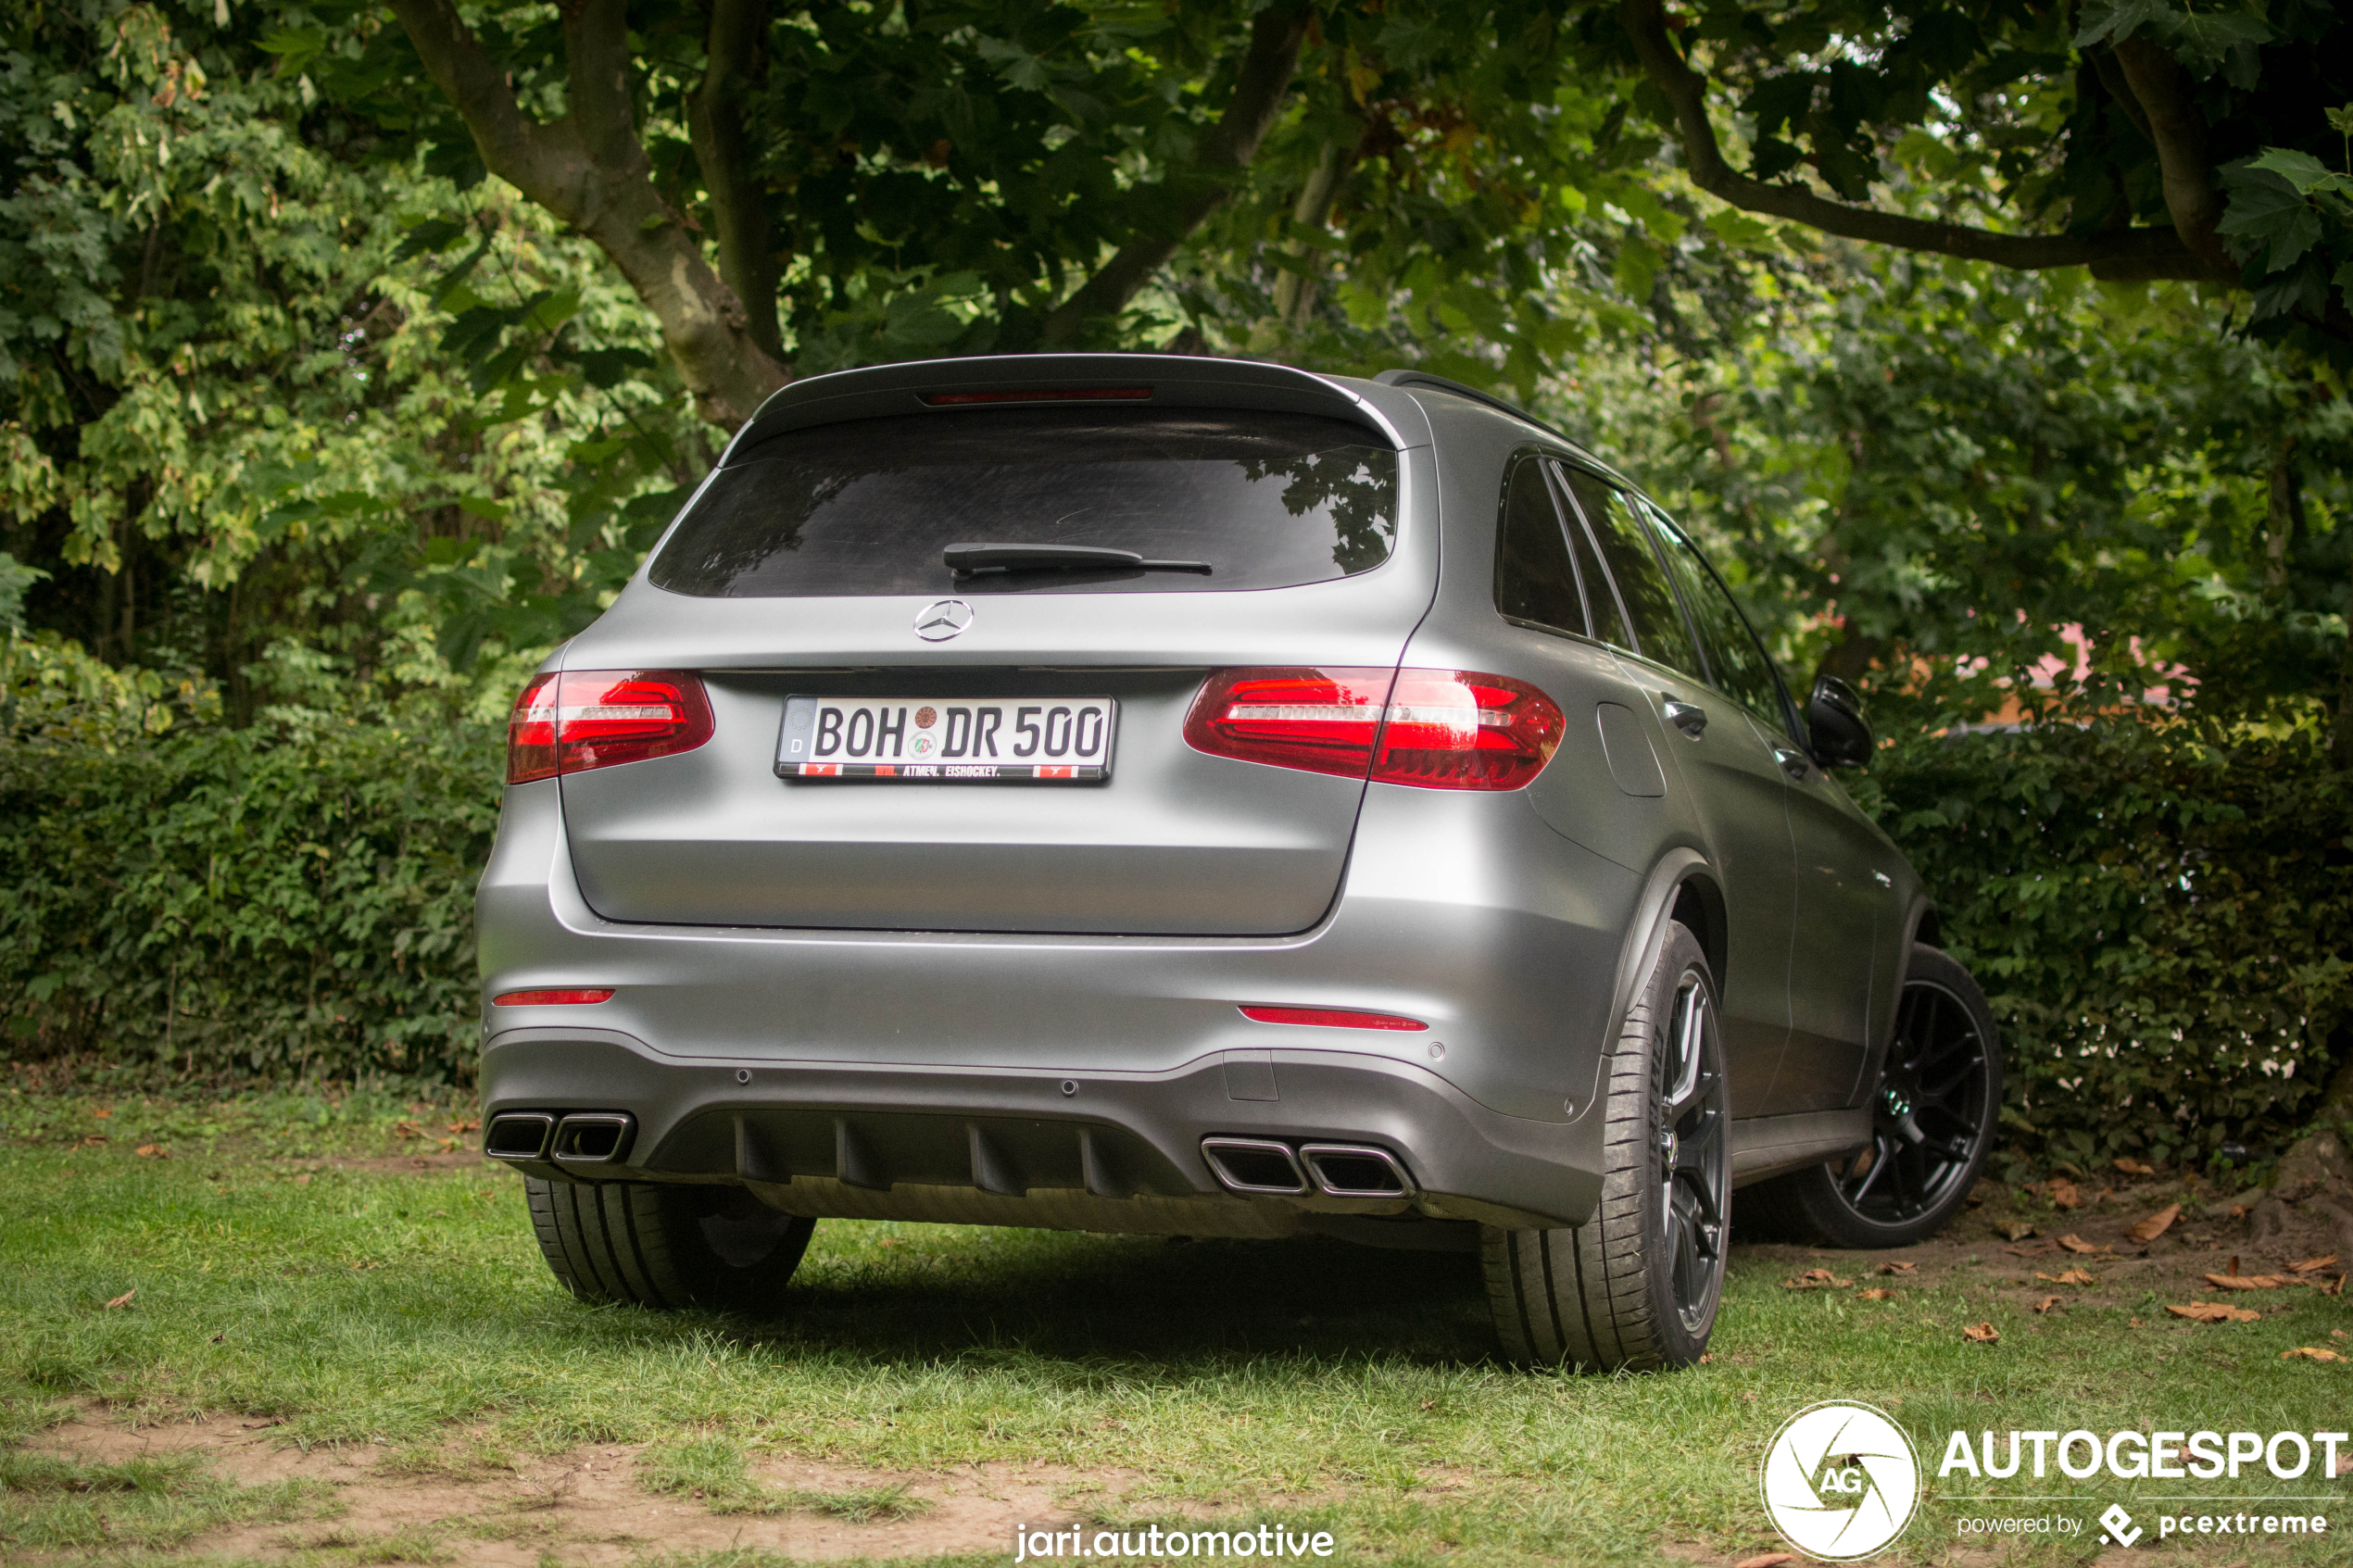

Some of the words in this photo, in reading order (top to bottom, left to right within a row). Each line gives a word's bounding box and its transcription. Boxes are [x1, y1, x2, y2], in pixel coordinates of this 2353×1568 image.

[789, 738, 803, 754] D
[814, 707, 907, 757] BOH
[940, 707, 1002, 758] DR
[1013, 706, 1104, 758] 500
[902, 765, 939, 777] ATMEN.
[945, 765, 1000, 778] EISHOCKEY.
[1649, 1031, 1664, 1186] MICHELIN
